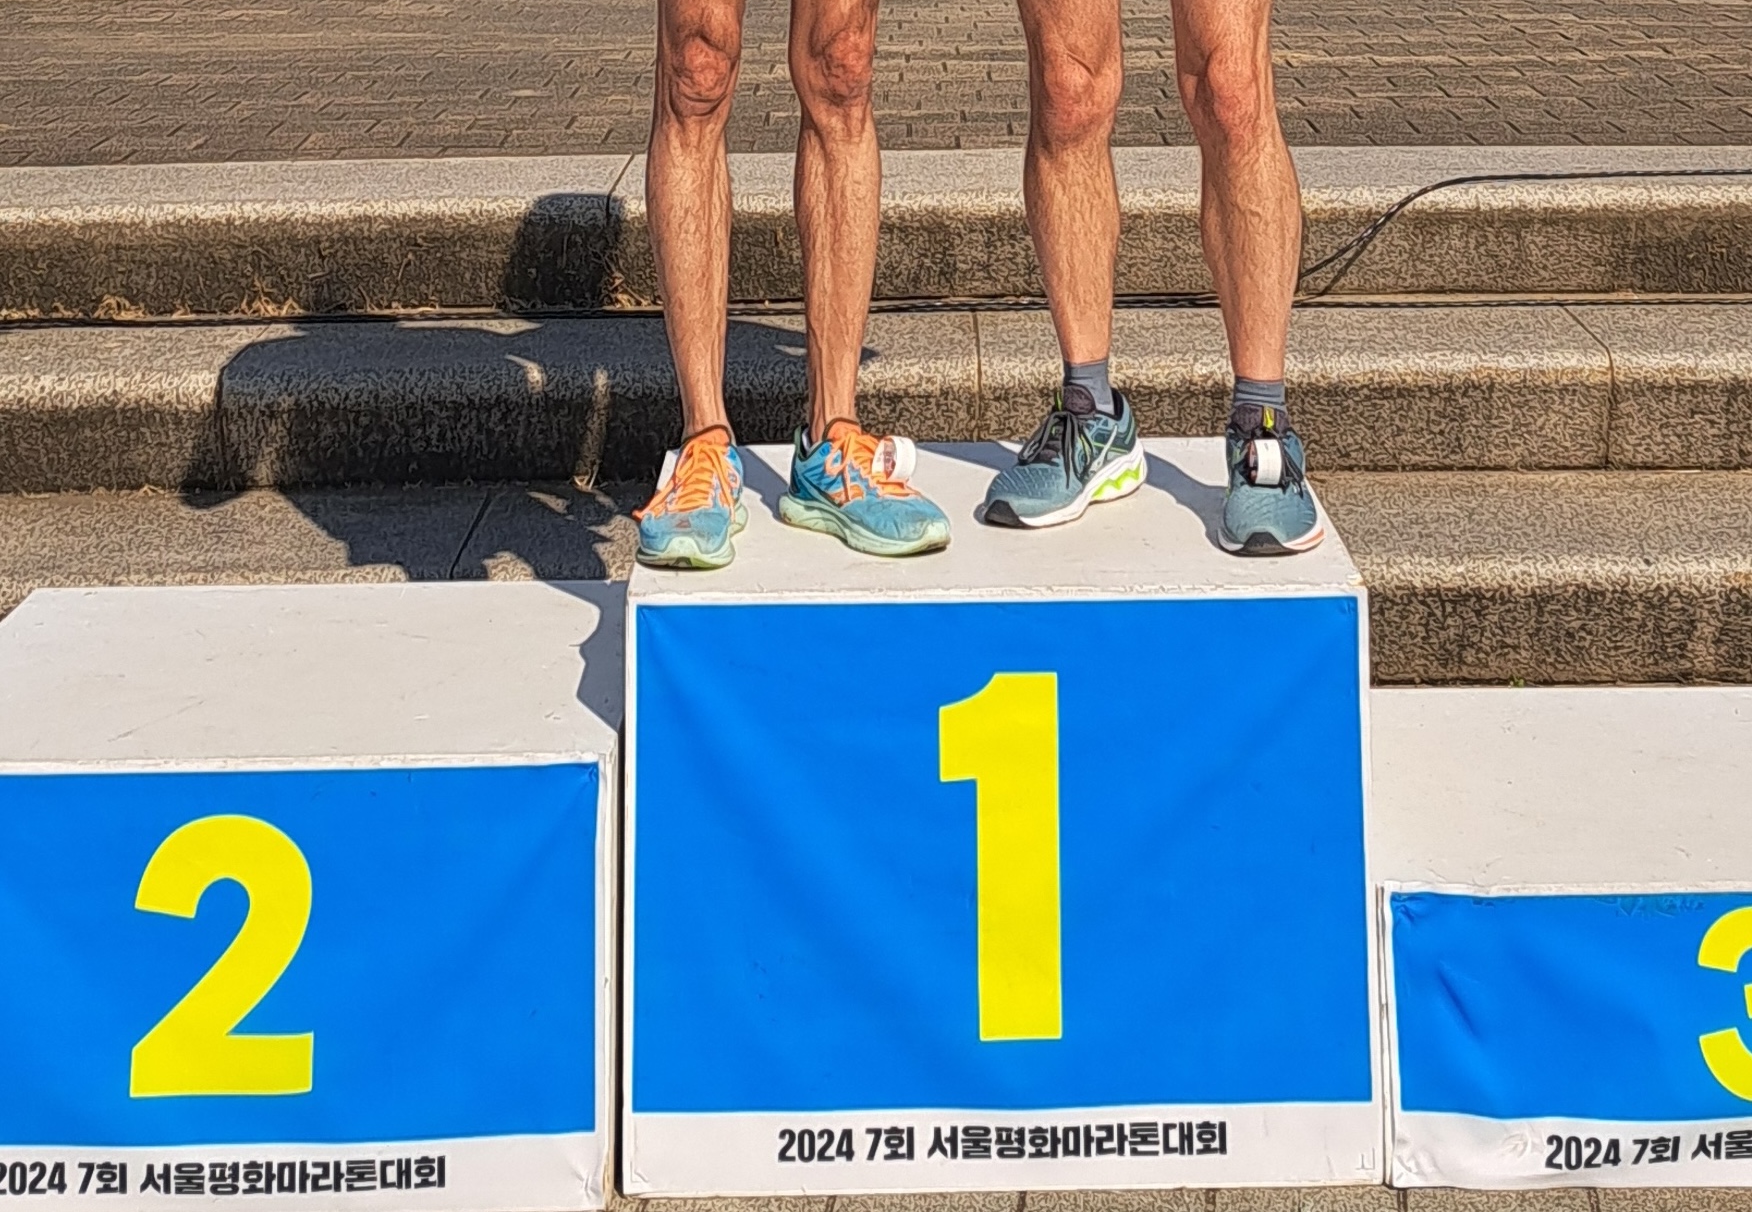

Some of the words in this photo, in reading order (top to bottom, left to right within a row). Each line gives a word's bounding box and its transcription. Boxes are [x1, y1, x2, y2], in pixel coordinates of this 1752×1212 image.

[938, 670, 1063, 1041] 1
[129, 813, 315, 1098] 2
[1697, 904, 1752, 1102] 3
[0, 1161, 67, 1196] 2024
[77, 1160, 128, 1195] 7회
[139, 1155, 447, 1195] 서울평화마라톤대회
[778, 1128, 855, 1163] 2024
[866, 1125, 915, 1162] 7회
[927, 1119, 1228, 1160] 서울평화마라톤대회
[1544, 1134, 1621, 1171] 2024
[1630, 1134, 1681, 1165] 7회
[1691, 1129, 1752, 1162] 서울
